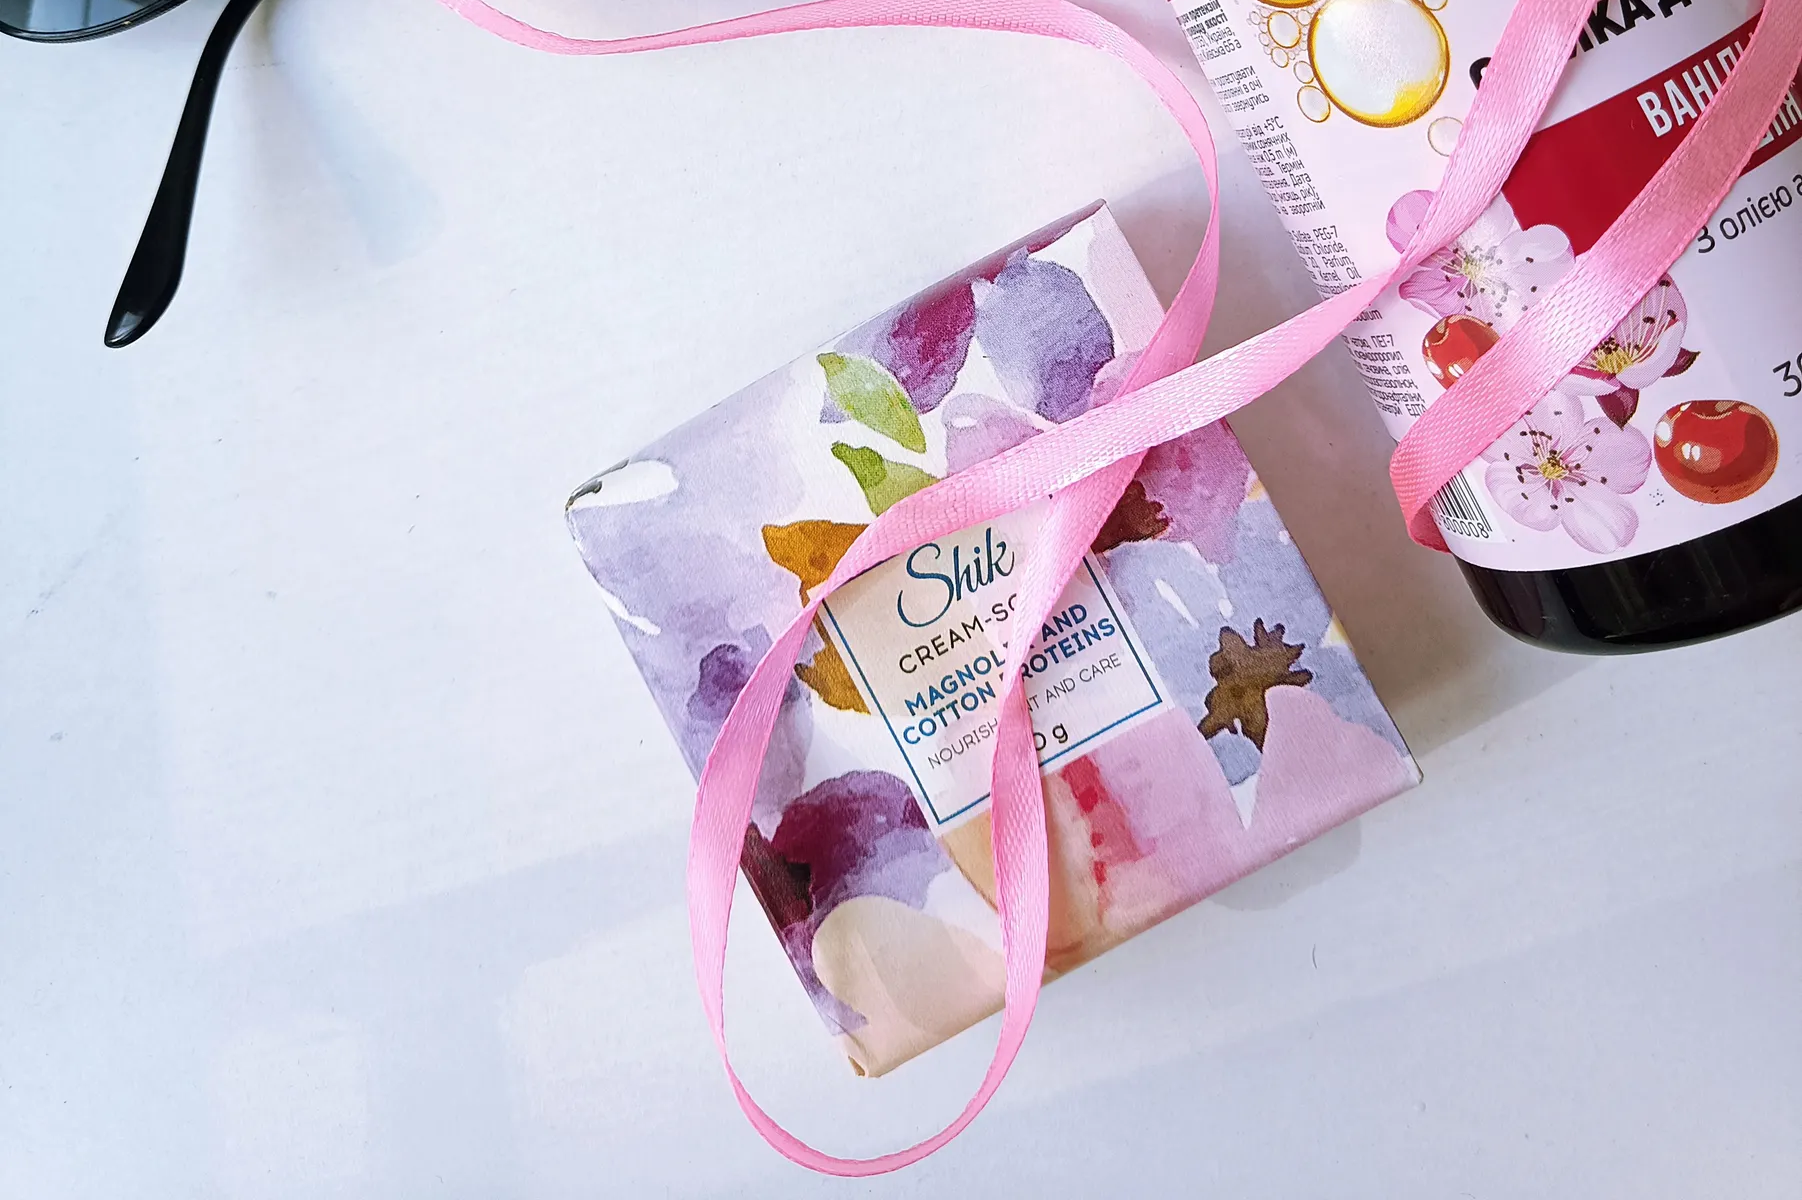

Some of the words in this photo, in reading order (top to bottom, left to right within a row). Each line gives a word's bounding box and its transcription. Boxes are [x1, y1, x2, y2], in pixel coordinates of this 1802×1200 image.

[1720, 184, 1793, 241] олією
[897, 527, 1015, 628] Shik
[899, 593, 1017, 674] CREAM-S
[904, 642, 1034, 717] MAGNOL
[1041, 604, 1088, 642] AND
[903, 681, 997, 745] COTTON
[999, 618, 1116, 682] ROTEINS
[1045, 677, 1077, 706] AND
[1079, 653, 1122, 683] CARE
[1052, 722, 1069, 744] g
